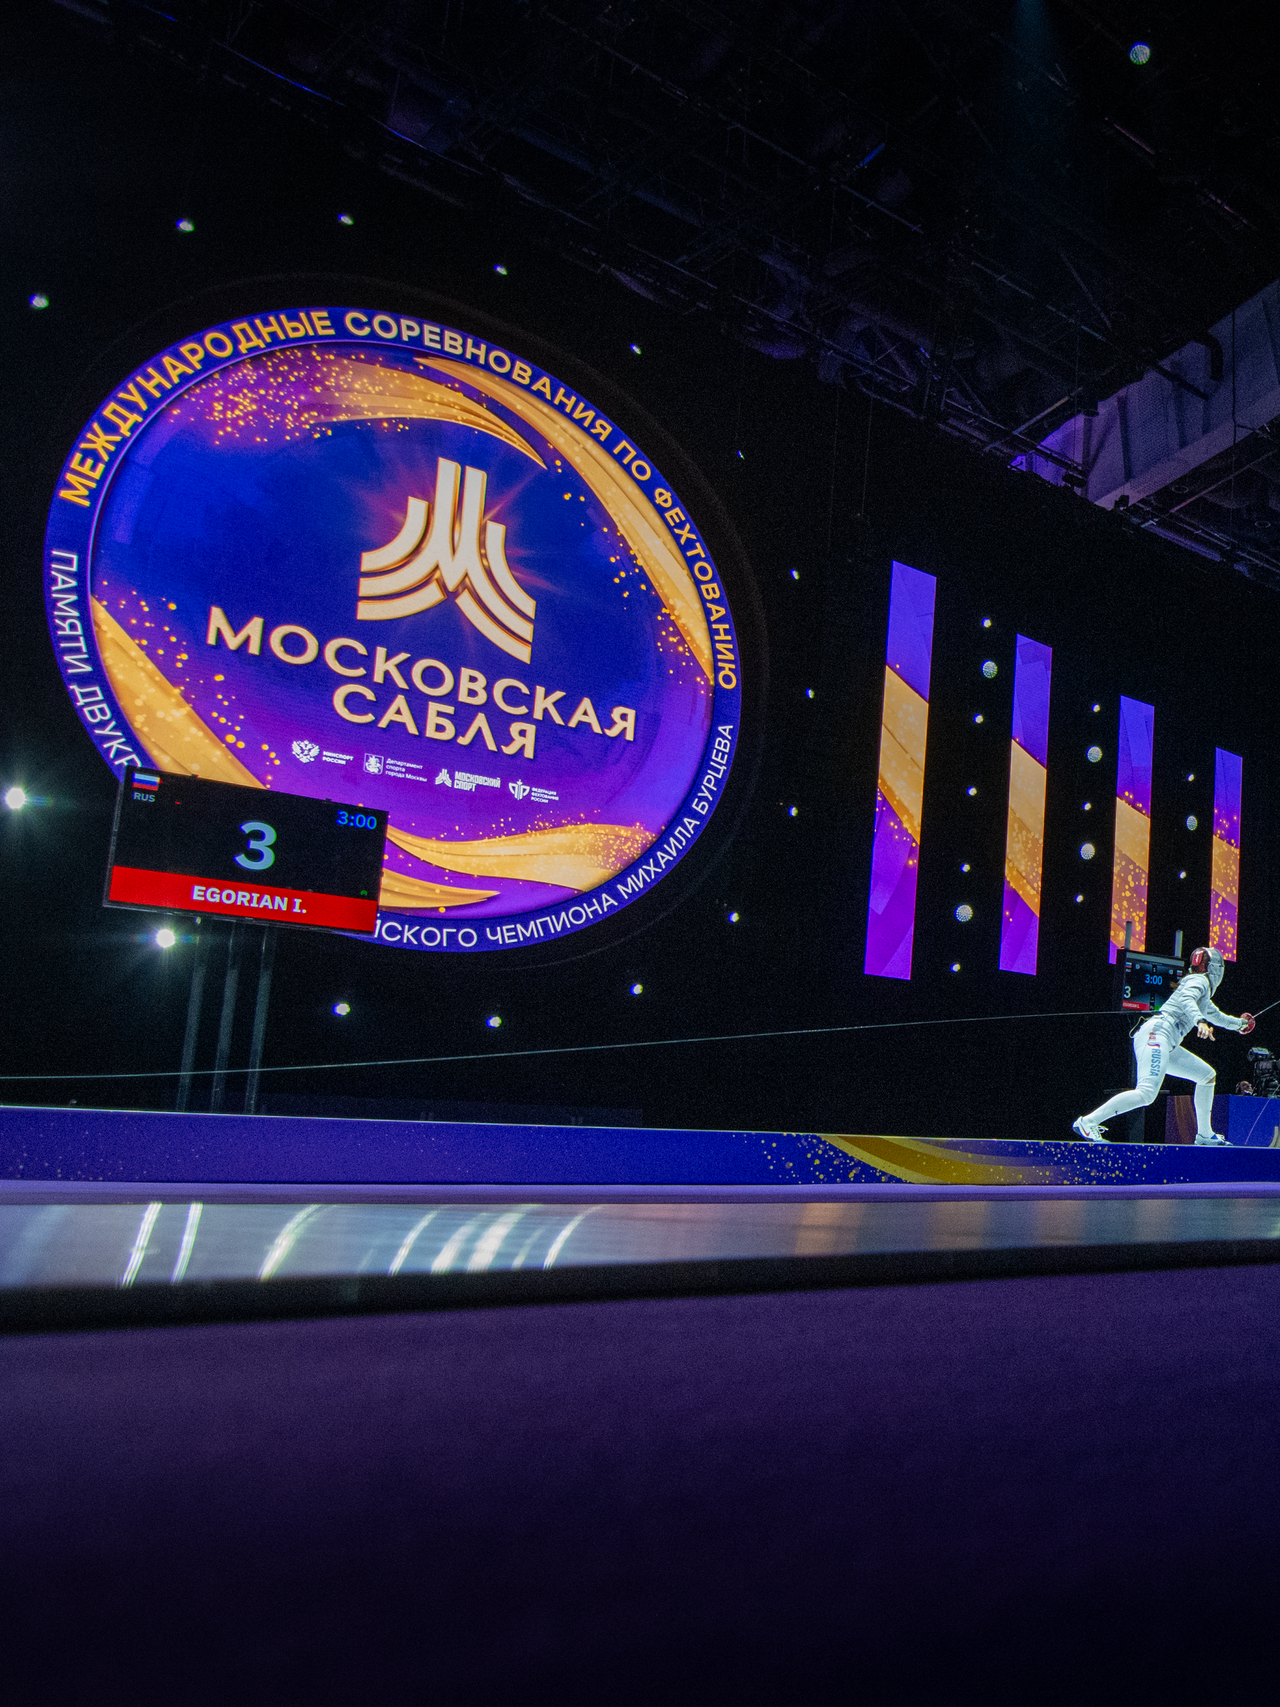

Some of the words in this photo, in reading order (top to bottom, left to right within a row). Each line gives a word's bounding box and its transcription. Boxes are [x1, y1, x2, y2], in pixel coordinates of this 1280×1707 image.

[58, 310, 336, 507] МЕЖДУНАРОДНЫЕ
[344, 311, 613, 442] СОРЕВНОВАНИЯ
[613, 440, 652, 481] ПО
[654, 487, 738, 690] ФЕХТОВАНИЮ
[50, 550, 93, 673] ПАМЯТИ
[206, 605, 637, 741] МОСКОВСКАЯ
[332, 683, 537, 759] САБЛЯ
[386, 758, 423, 770] Департамент
[454, 771, 501, 788] МОСКОВСКИЙ
[454, 779, 476, 792] СПОРТ
[133, 791, 156, 803] RUS
[336, 809, 377, 830] 3:00
[233, 820, 278, 871] 3
[486, 892, 619, 945] ЧЕМПИОНА
[616, 815, 701, 900] МИХАИЛА
[692, 724, 734, 815] БУРЦЕВА
[191, 885, 288, 911] EGORIAN
[292, 898, 308, 914] I.
[1124, 985, 1131, 998] 3
[1145, 974, 1162, 985] 3:00
